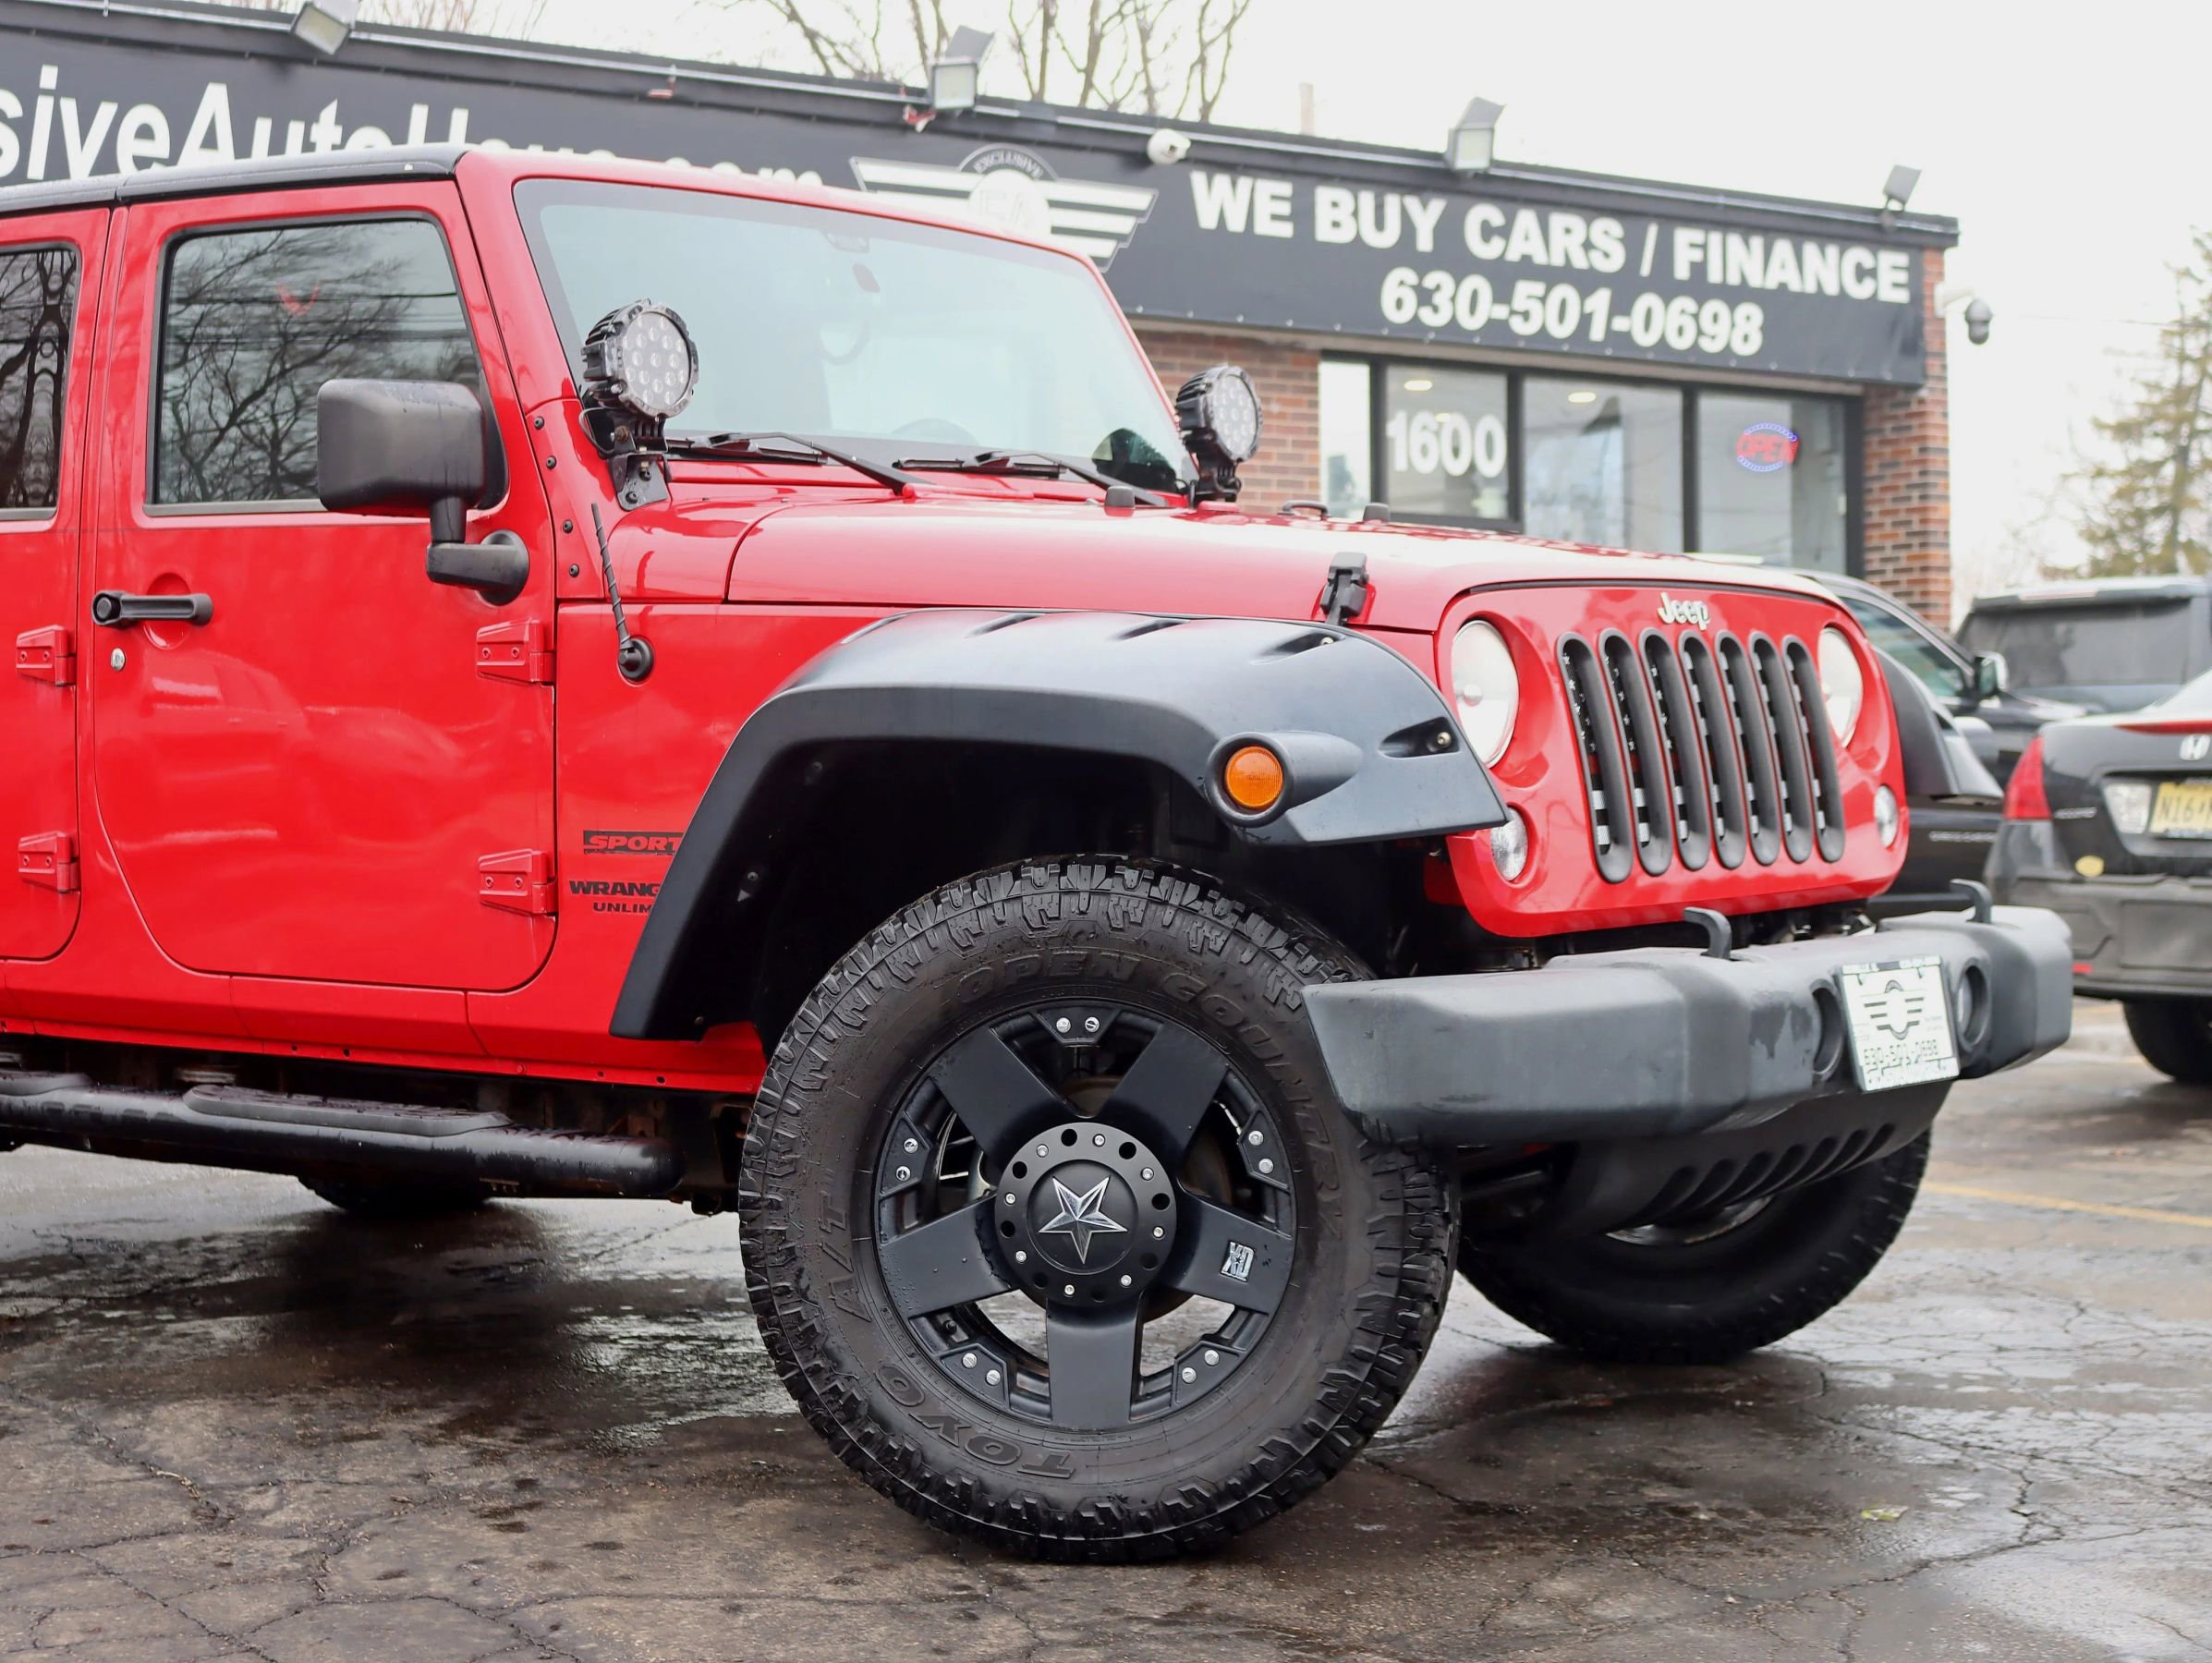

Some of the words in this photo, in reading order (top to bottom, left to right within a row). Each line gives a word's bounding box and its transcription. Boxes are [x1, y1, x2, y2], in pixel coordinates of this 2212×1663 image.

[1189, 170, 1294, 238] WE
[1313, 185, 1448, 253] BUY
[1464, 203, 1626, 273] CARS
[1673, 226, 1911, 305] FINANCE
[1379, 266, 1765, 358] 630-501-0698
[1386, 410, 1508, 479] 1600
[1657, 591, 1710, 631] Jeep
[583, 834, 683, 851] SPORT
[958, 949, 1142, 1005] OPEN
[874, 1362, 1077, 1480] TOYO
